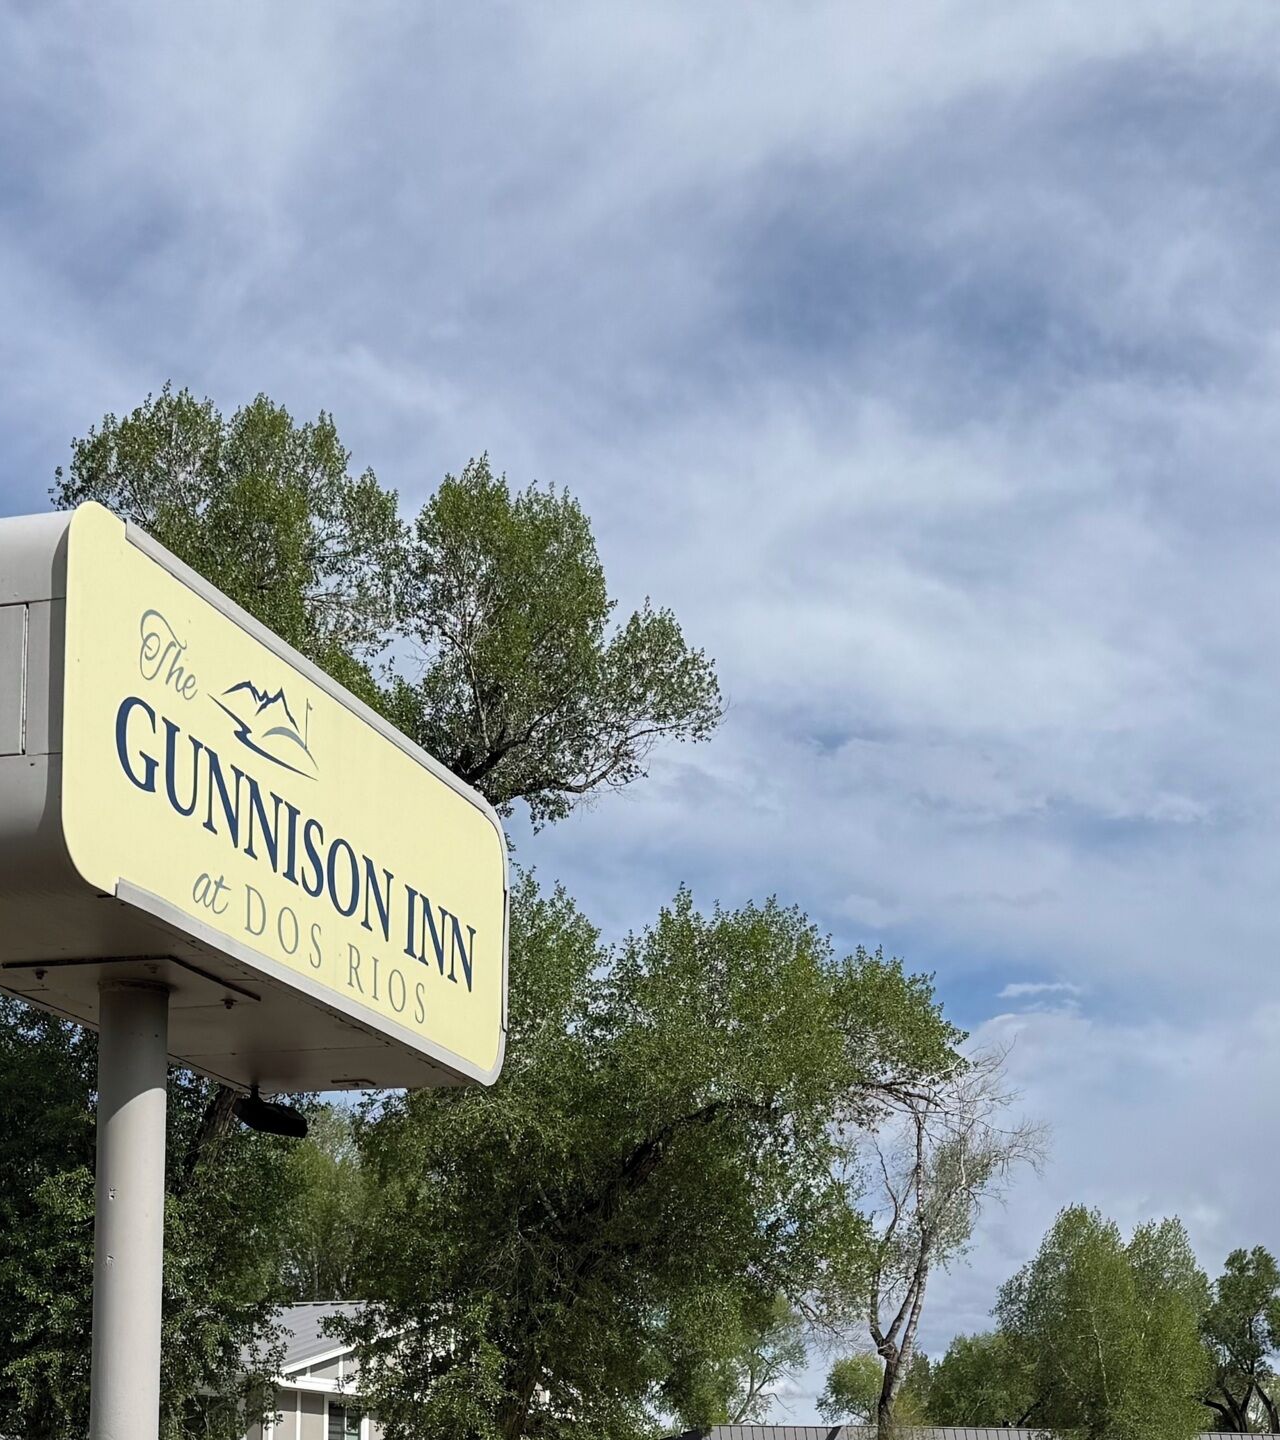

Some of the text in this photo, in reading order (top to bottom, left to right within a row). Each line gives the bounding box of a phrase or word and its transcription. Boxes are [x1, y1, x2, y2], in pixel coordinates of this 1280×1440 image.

[140, 609, 198, 700] The
[115, 696, 476, 992] GUNNISON INN
[193, 873, 426, 1024] at DOS RIOS
